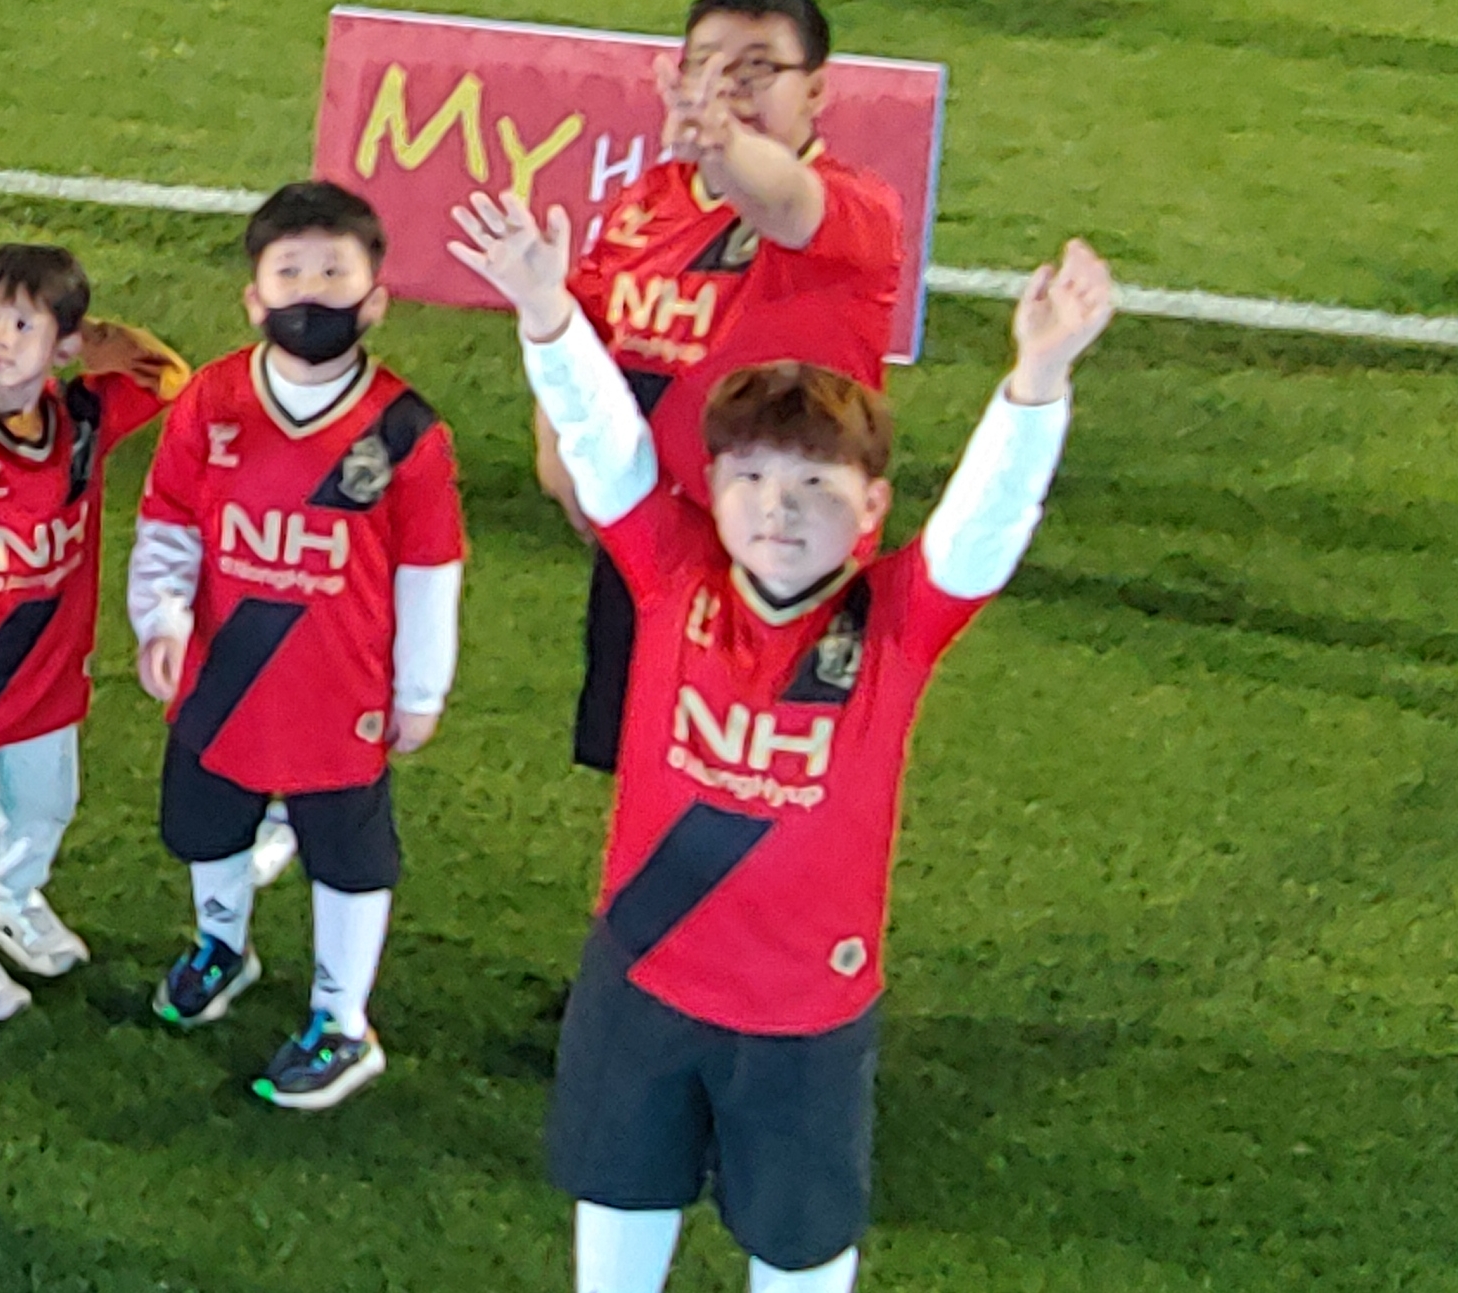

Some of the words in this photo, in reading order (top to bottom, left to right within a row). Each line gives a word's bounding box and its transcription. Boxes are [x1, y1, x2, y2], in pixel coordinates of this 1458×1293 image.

[607, 272, 718, 338] NH
[220, 502, 350, 569] NH
[674, 685, 833, 777] NH
